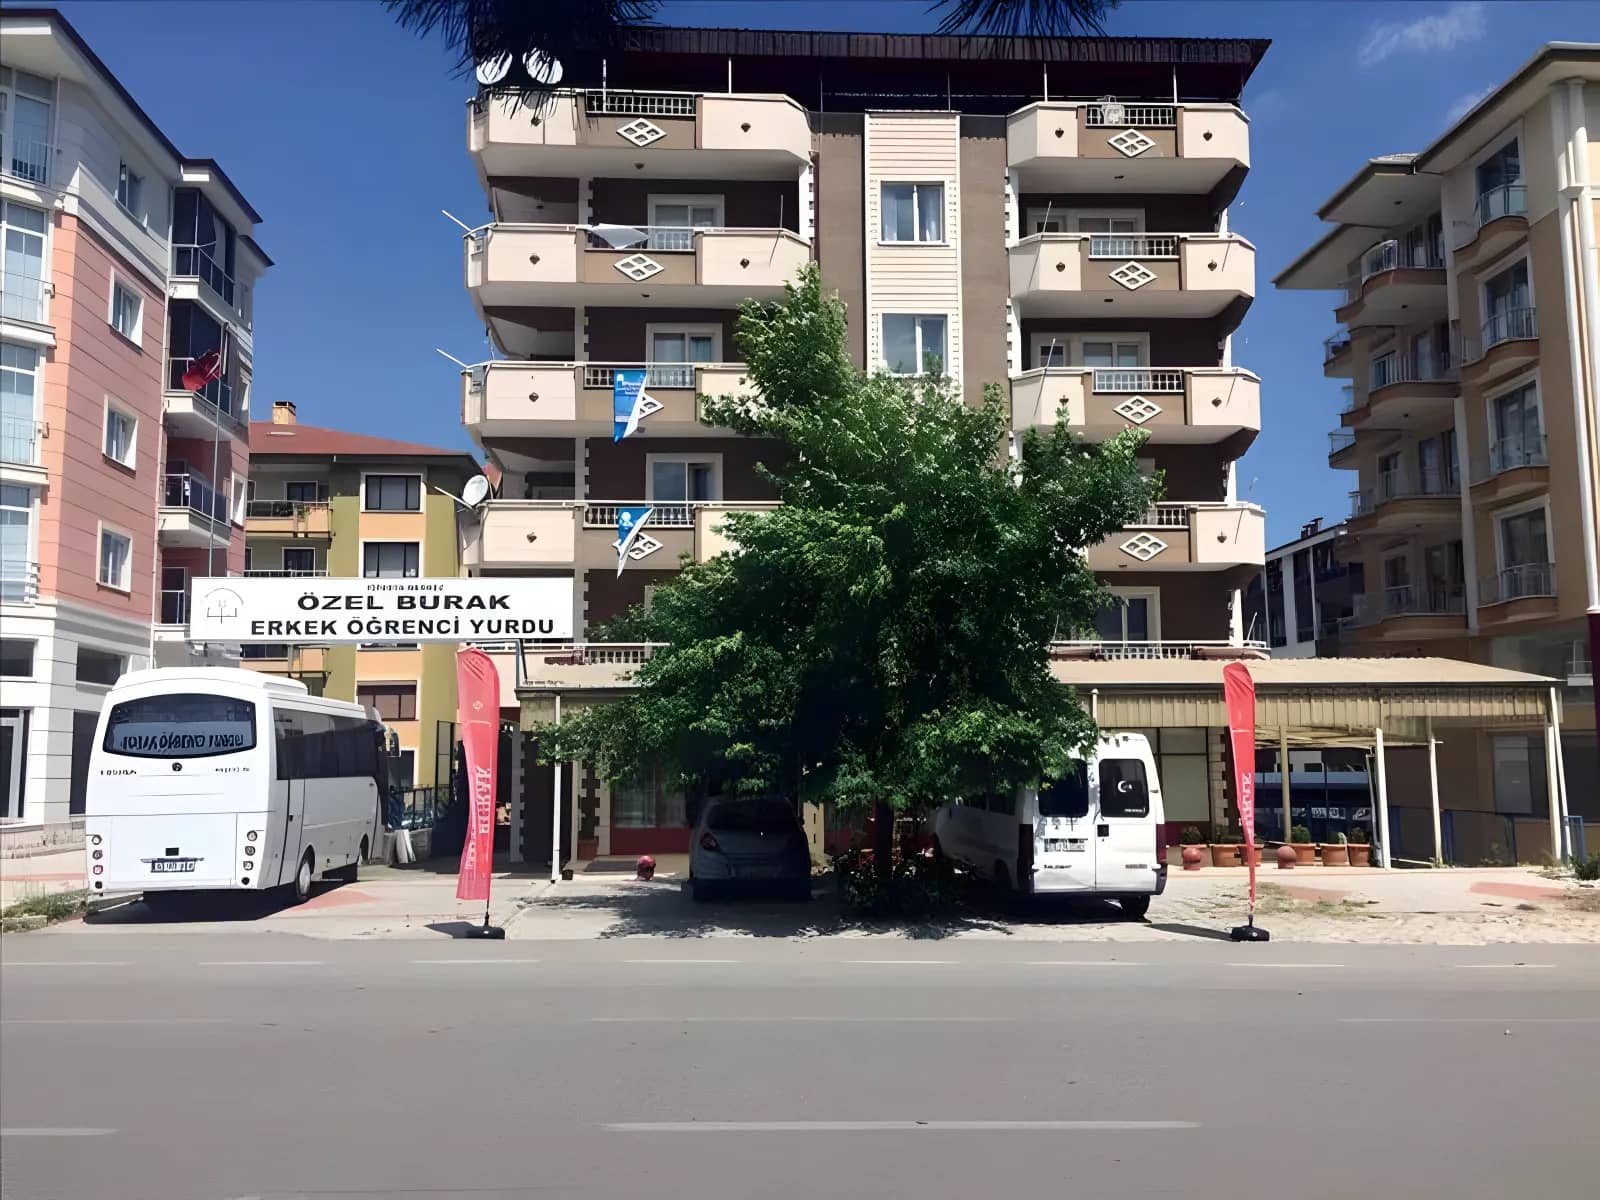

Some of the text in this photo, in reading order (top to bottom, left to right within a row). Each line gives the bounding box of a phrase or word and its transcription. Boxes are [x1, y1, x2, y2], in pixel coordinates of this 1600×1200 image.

[297, 590, 511, 611] ÖZEL BURAK
[251, 615, 554, 636] ERKEK ÖĞRENCİ YURDU
